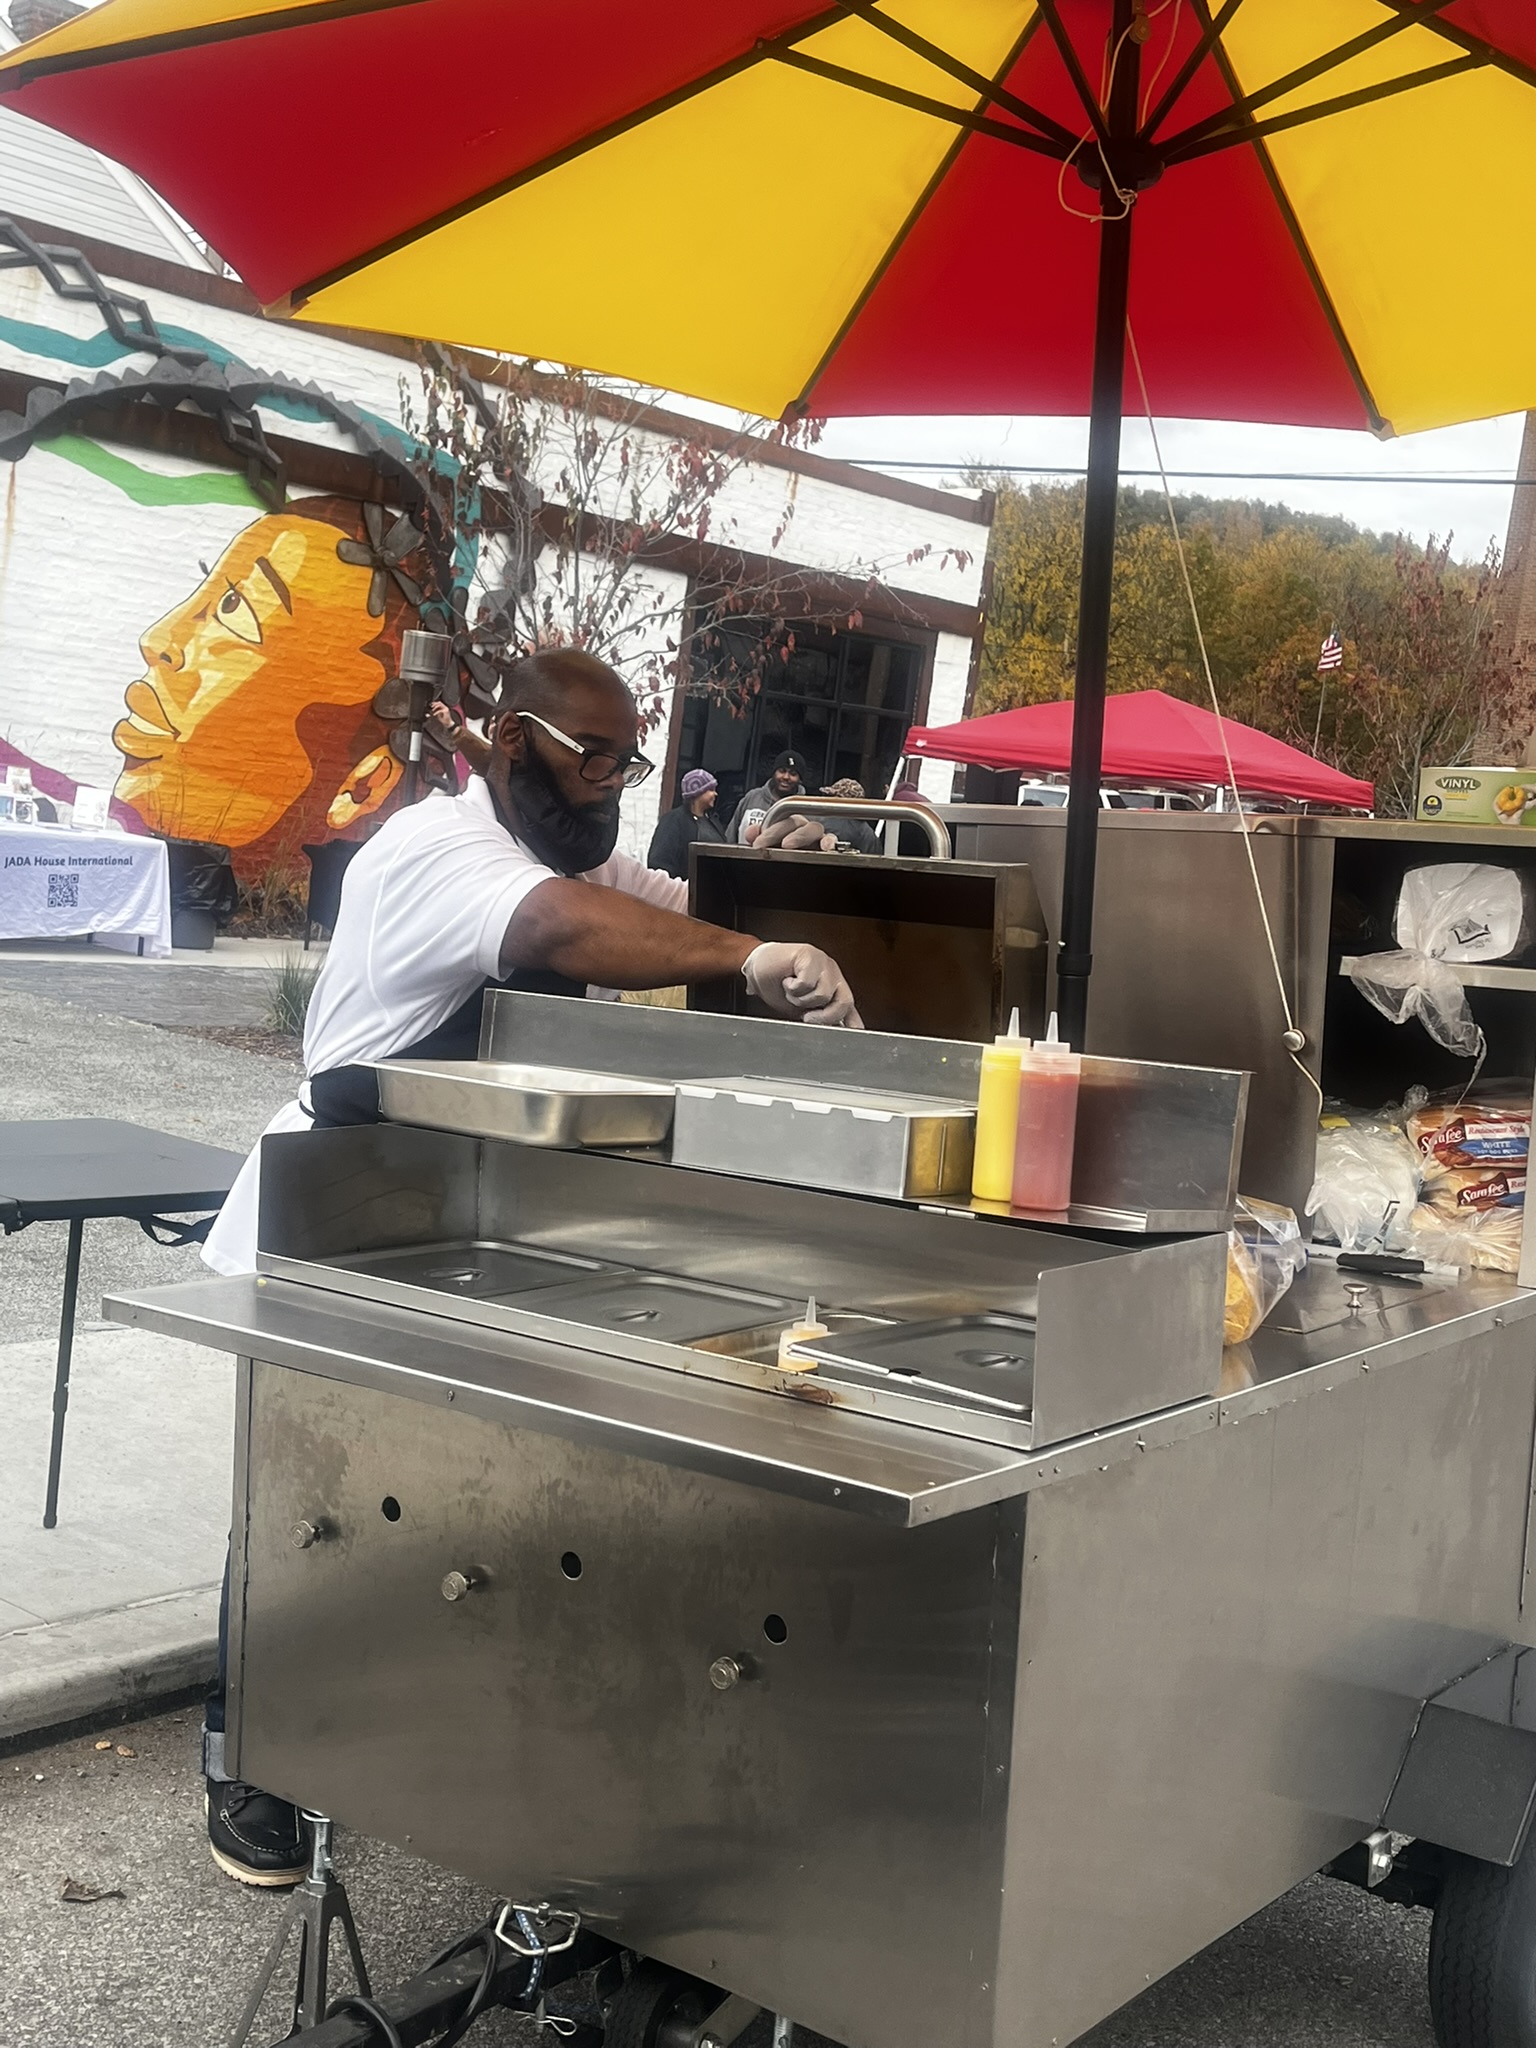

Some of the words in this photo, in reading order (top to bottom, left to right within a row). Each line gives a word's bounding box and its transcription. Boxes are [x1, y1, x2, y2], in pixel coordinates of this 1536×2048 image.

[1441, 778, 1476, 789] VINYL
[4, 856, 31, 869] JADA
[34, 856, 66, 867] House
[68, 855, 133, 867] International
[1421, 1134, 1445, 1153] Sa
[1481, 1141, 1512, 1149] WHITE
